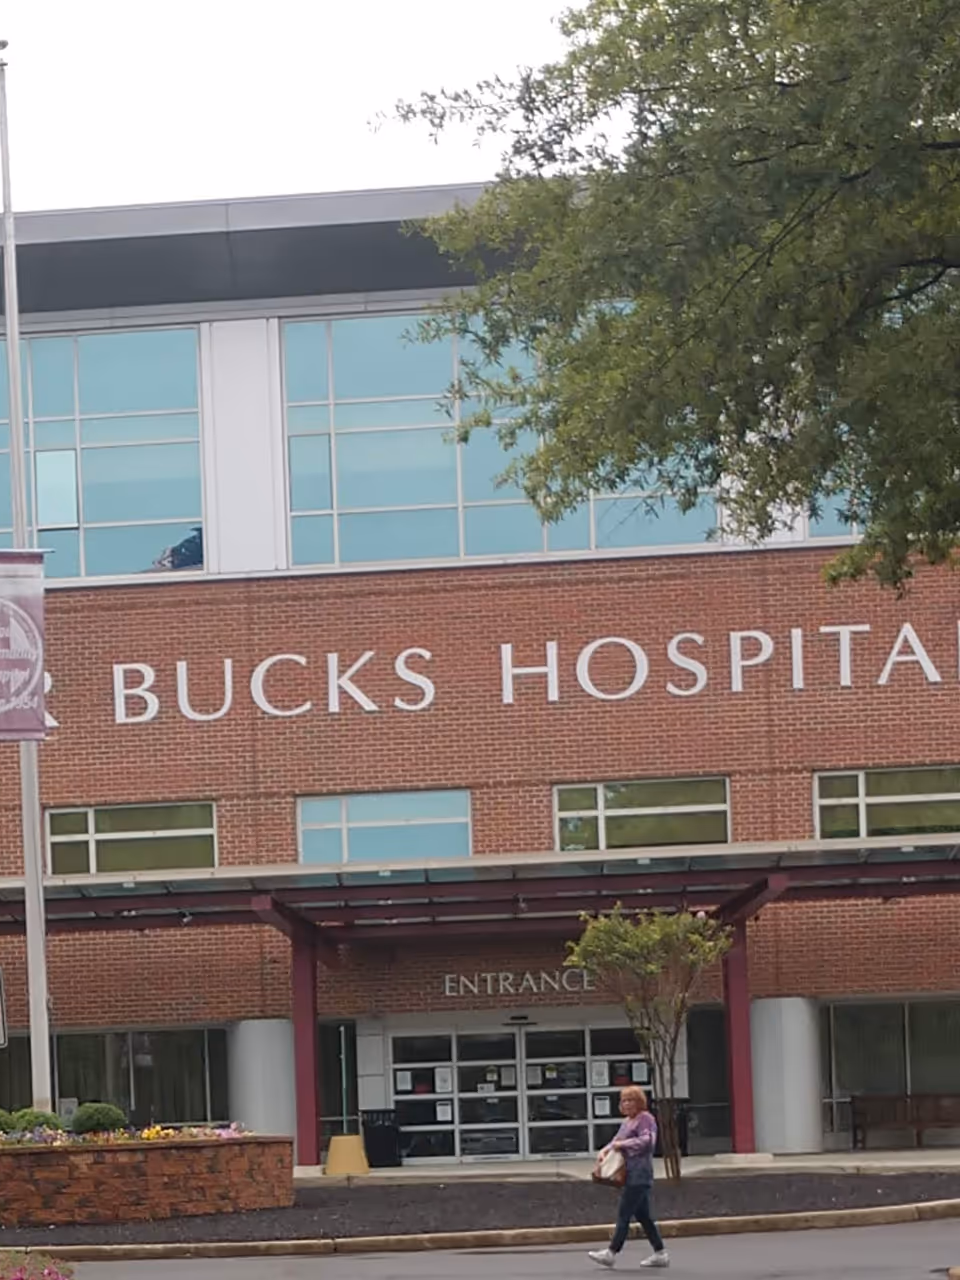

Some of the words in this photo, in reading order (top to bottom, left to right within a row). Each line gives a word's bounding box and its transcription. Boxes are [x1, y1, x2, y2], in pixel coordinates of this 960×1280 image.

[112, 648, 437, 726] BUCKS
[500, 620, 960, 706] HOSPITA
[444, 967, 596, 996] ENTRANCE
